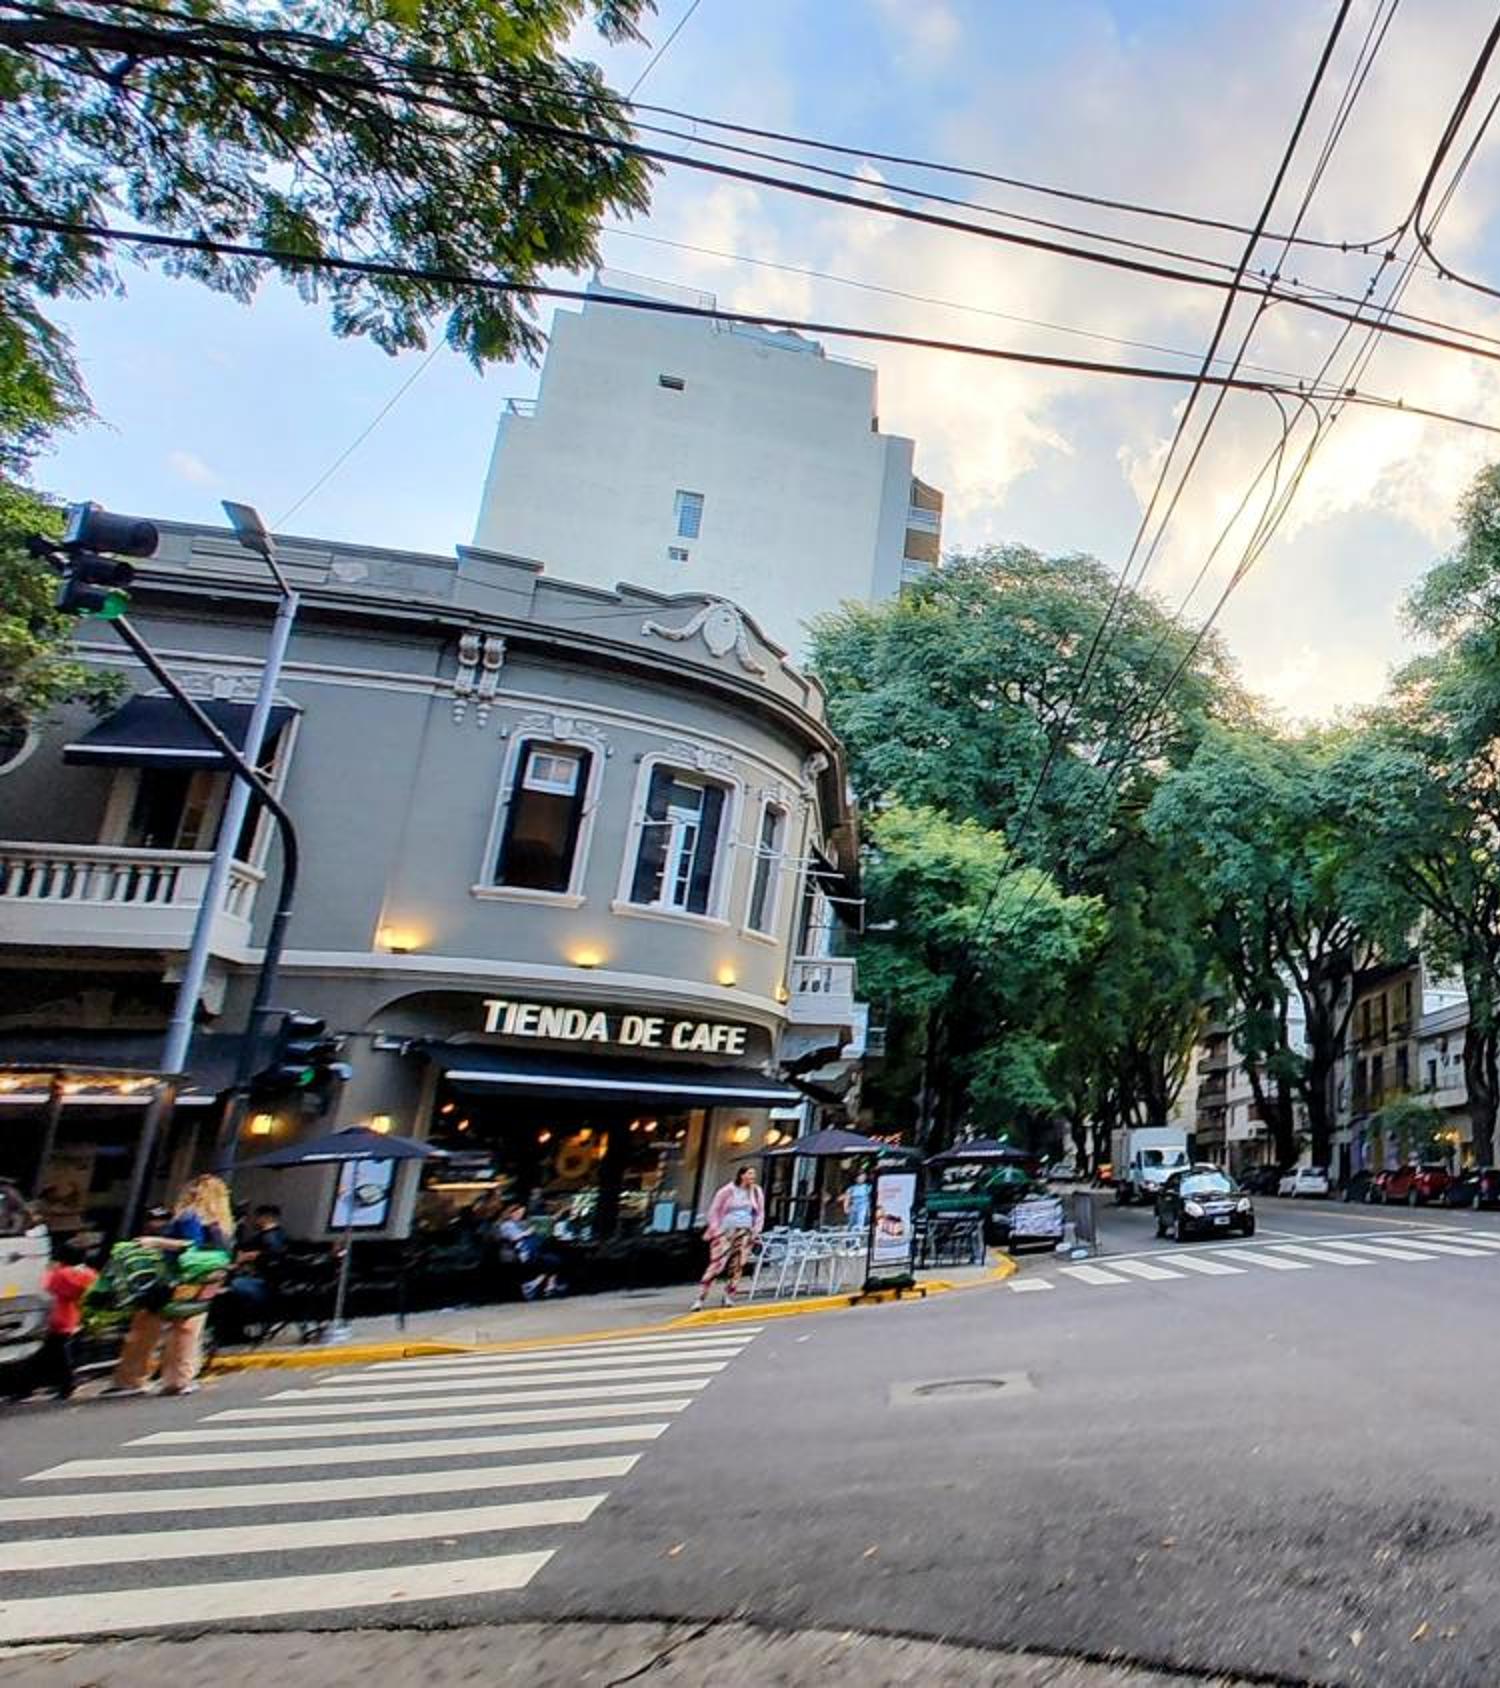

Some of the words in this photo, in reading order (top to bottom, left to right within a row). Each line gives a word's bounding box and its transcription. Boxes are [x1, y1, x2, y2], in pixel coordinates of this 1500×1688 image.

[483, 1000, 609, 1042] TIENDA
[618, 1015, 665, 1047] DE
[671, 1021, 747, 1055] CAFE
